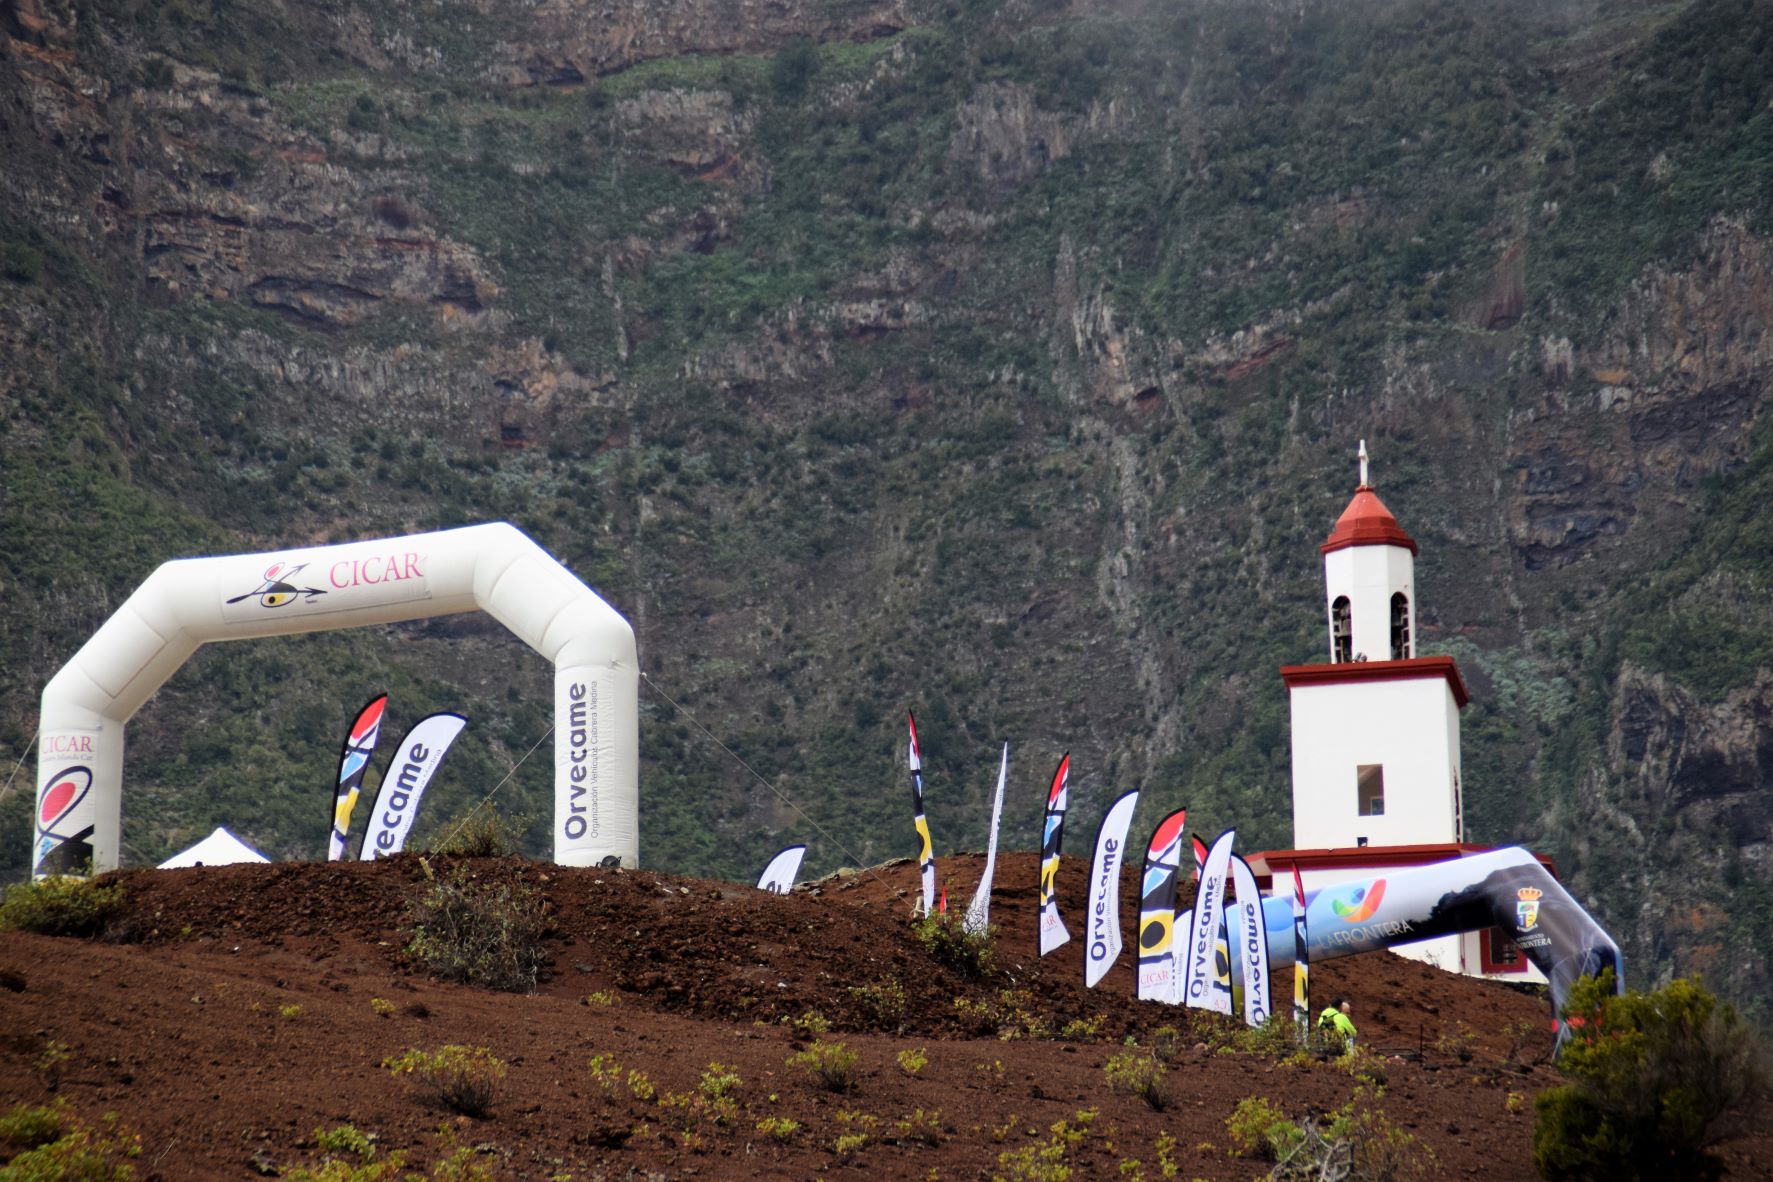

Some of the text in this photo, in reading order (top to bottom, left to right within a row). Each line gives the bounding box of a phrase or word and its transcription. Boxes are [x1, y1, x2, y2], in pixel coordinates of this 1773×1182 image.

[329, 552, 424, 589] CICAR
[590, 681, 598, 710] Medina
[564, 682, 587, 840] Orvecame
[1090, 837, 1118, 962] Orvecame
[1190, 875, 1217, 999] Orvecame
